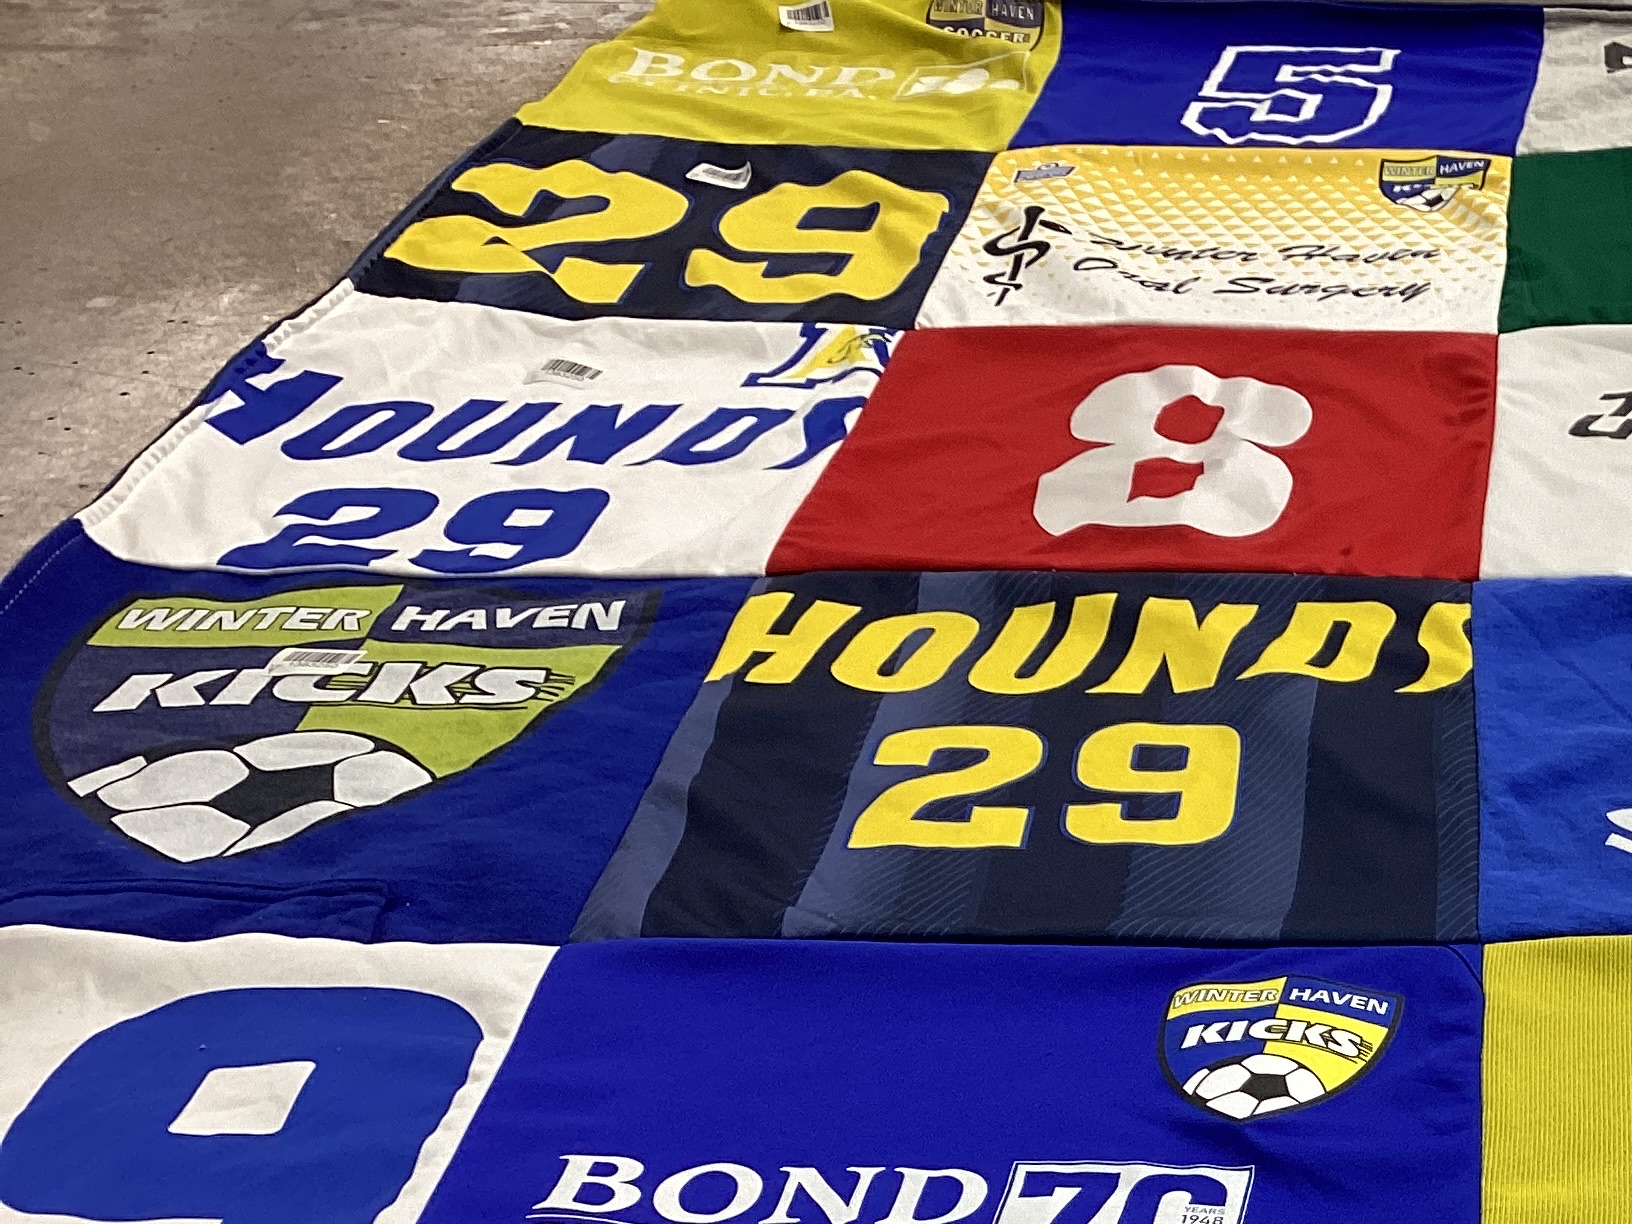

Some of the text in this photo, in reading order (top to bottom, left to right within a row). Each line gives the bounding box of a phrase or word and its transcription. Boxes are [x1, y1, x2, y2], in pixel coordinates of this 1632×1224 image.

[991, 2, 1034, 21] HAVEN
[618, 47, 896, 86] BOND
[1181, 46, 1402, 145] 5
[1440, 160, 1485, 175] HAVEN
[383, 160, 949, 304] 29
[1213, 276, 1431, 302] Surgery
[1033, 364, 1313, 537] 8
[216, 487, 610, 574] 29
[118, 600, 626, 633] WINTER HAVEN
[847, 722, 1242, 850] 29
[1171, 987, 1389, 1016] WINTER HAVEN
[1179, 1017, 1365, 1060] KICKS
[1184, 1206, 1226, 1215] YEARS
